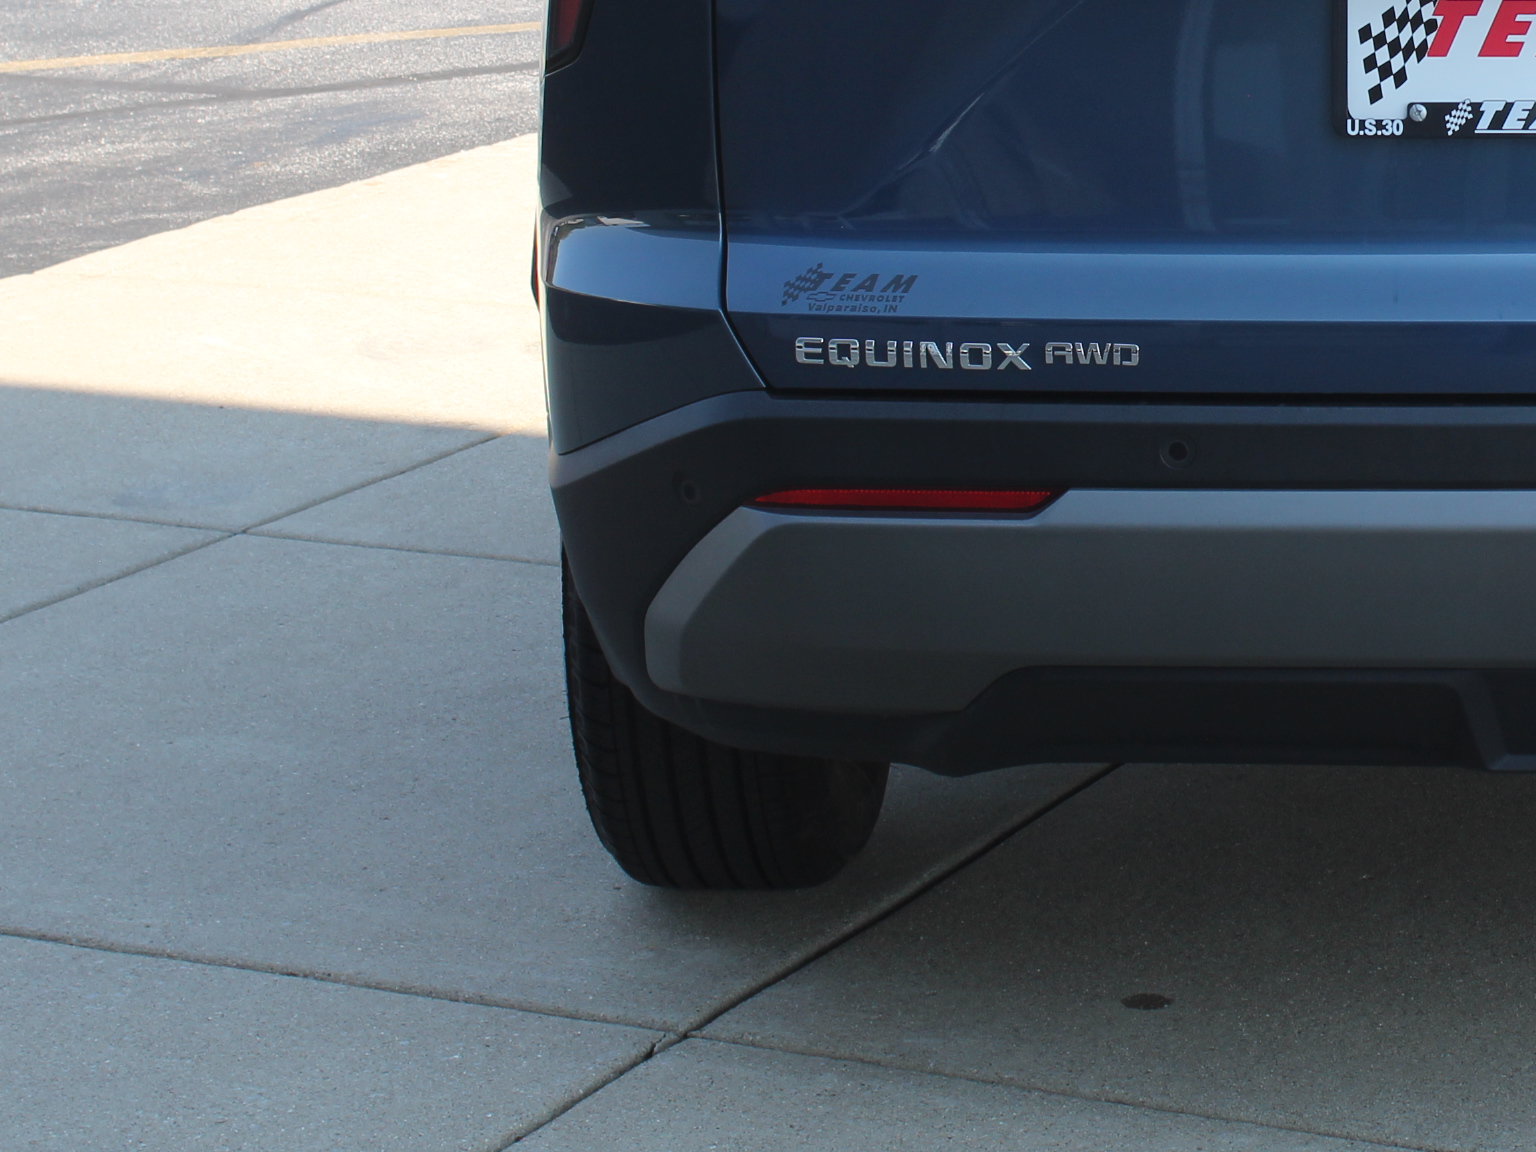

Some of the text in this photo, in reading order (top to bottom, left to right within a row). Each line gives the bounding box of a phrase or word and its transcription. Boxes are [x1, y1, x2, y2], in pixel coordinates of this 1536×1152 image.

[1346, 118, 1404, 136] U.S.30
[812, 272, 919, 294] TEAM
[839, 294, 905, 303] CHEVROLET
[807, 303, 898, 314] Valparaiso, IN
[795, 337, 1140, 370] EQUINOX AWD
